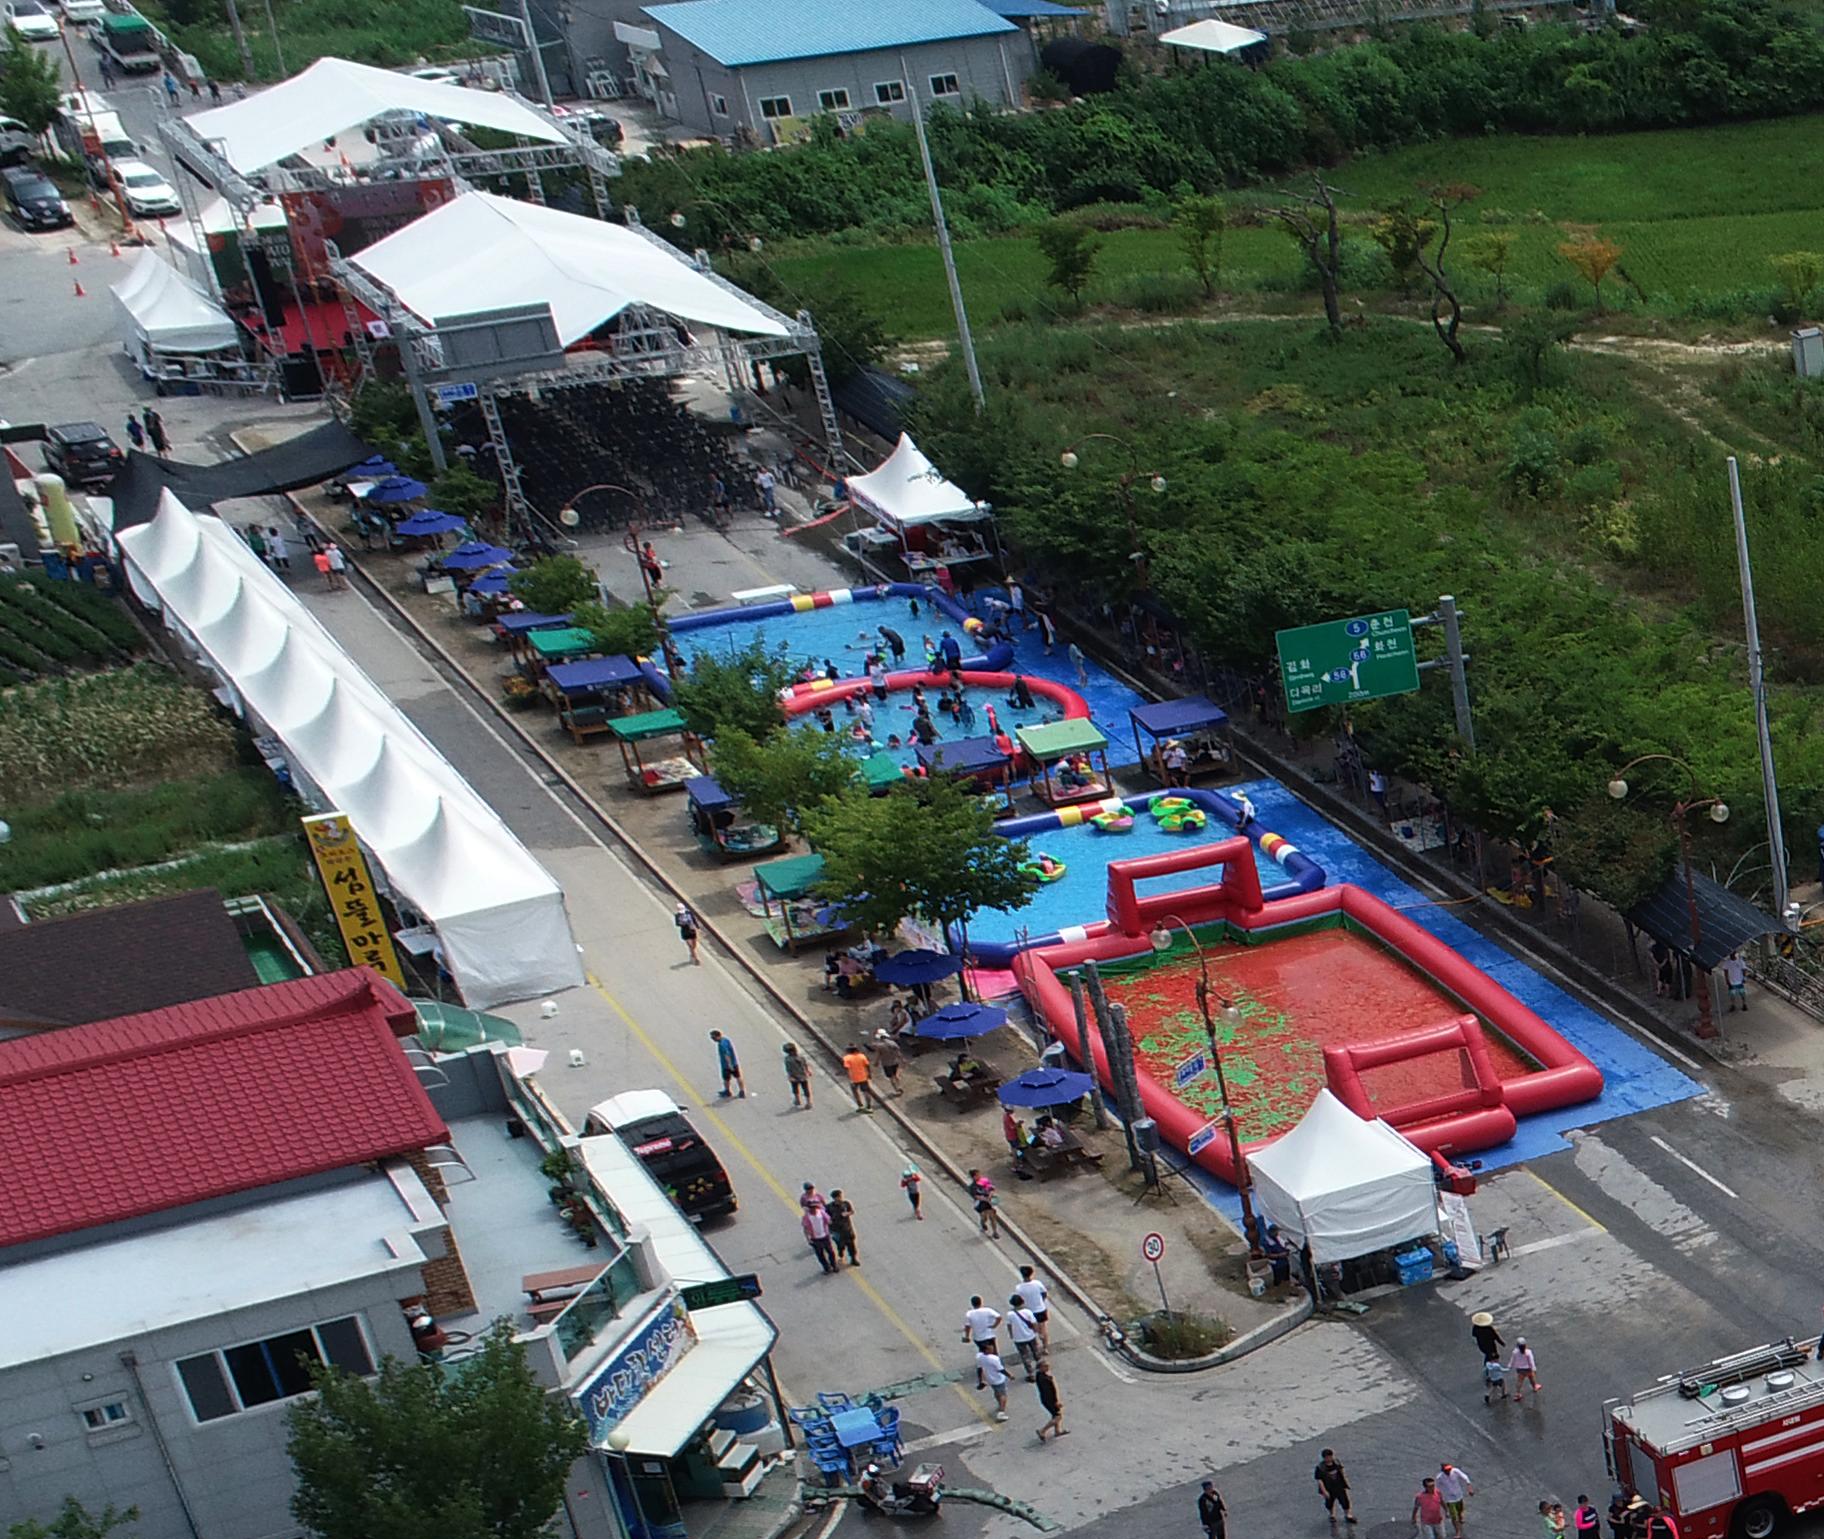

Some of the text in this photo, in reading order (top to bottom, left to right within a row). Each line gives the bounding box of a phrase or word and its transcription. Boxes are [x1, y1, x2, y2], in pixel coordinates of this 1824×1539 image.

[1353, 623, 1361, 633] 5
[1374, 637, 1397, 651] 화천
[1147, 1239, 1160, 1256] 30
